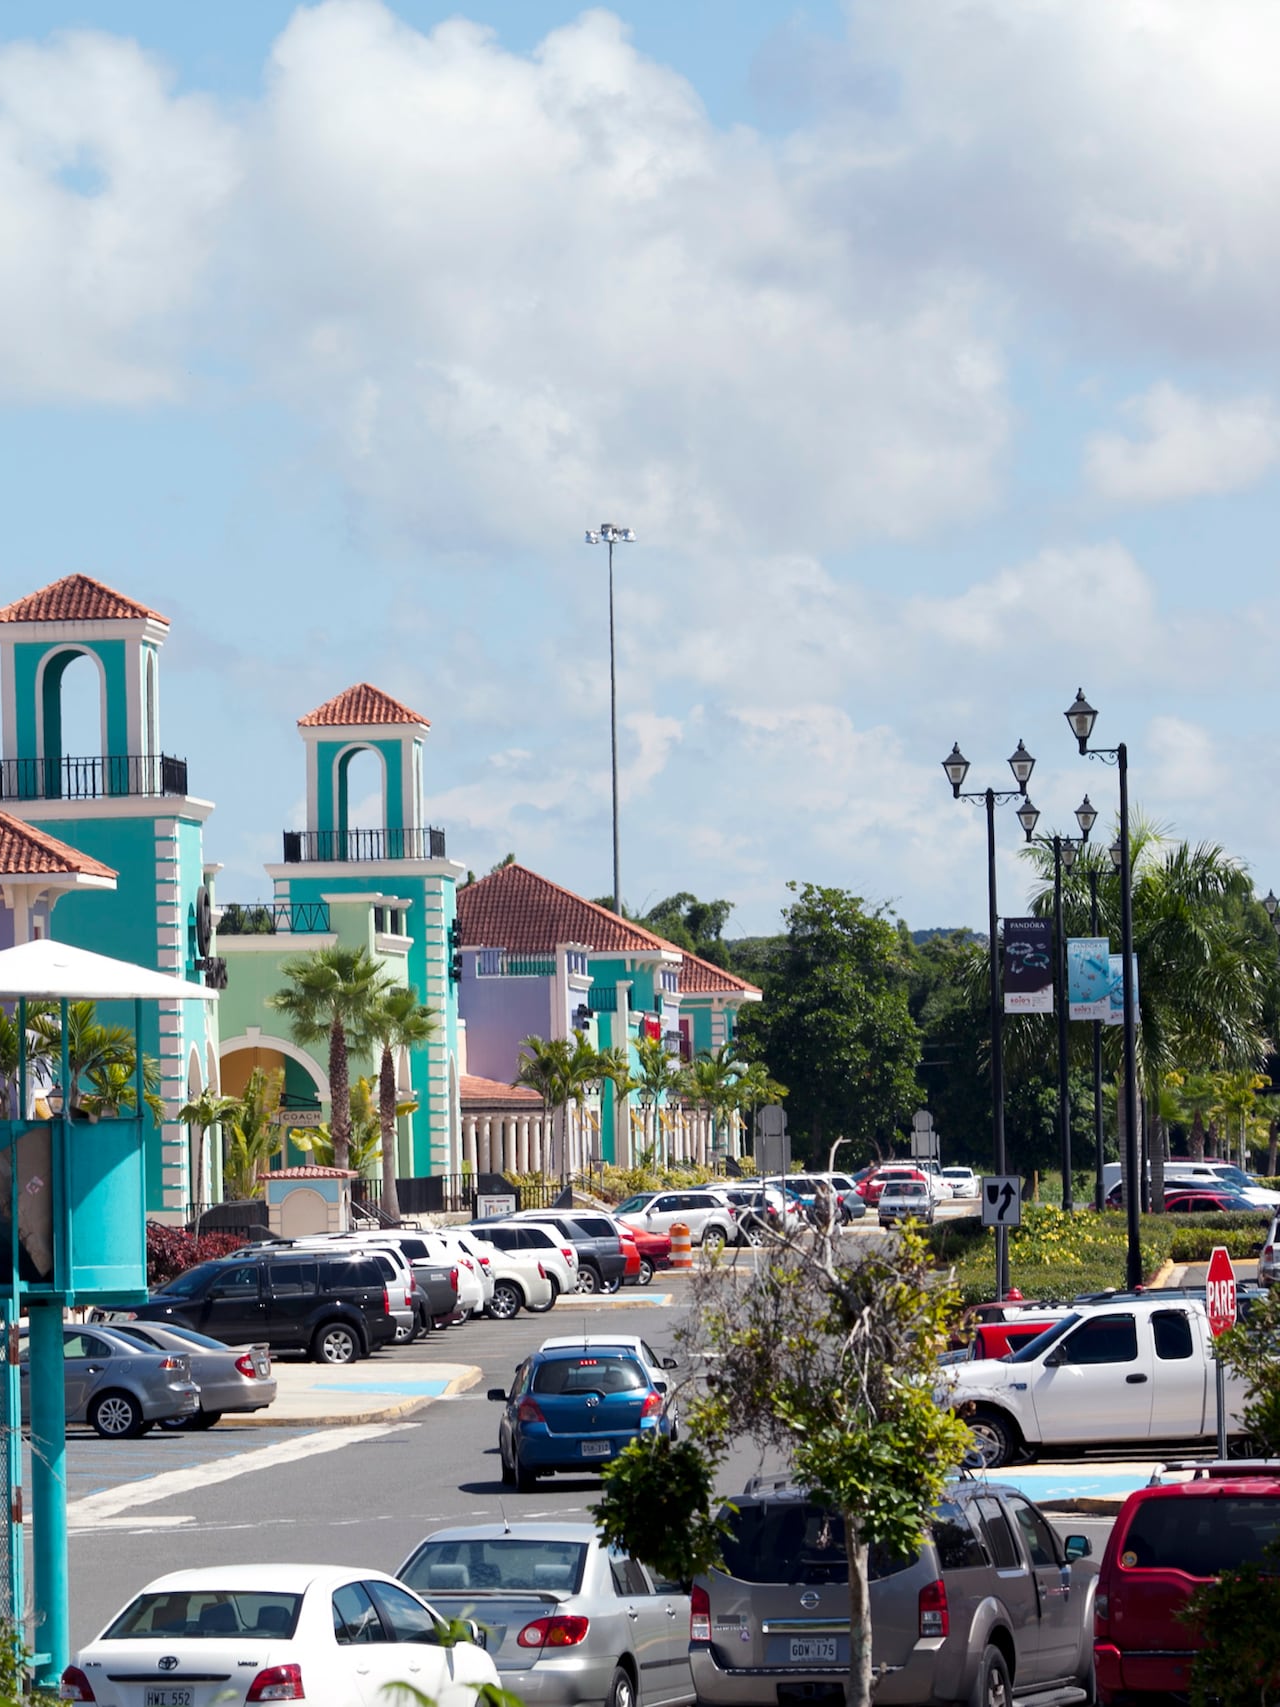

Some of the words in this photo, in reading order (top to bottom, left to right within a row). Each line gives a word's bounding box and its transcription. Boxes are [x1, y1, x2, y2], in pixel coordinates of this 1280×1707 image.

[282, 1113, 321, 1121] COACH
[1207, 1279, 1236, 1318] PARE
[147, 1692, 166, 1706] HWI
[171, 1692, 191, 1706] 552
